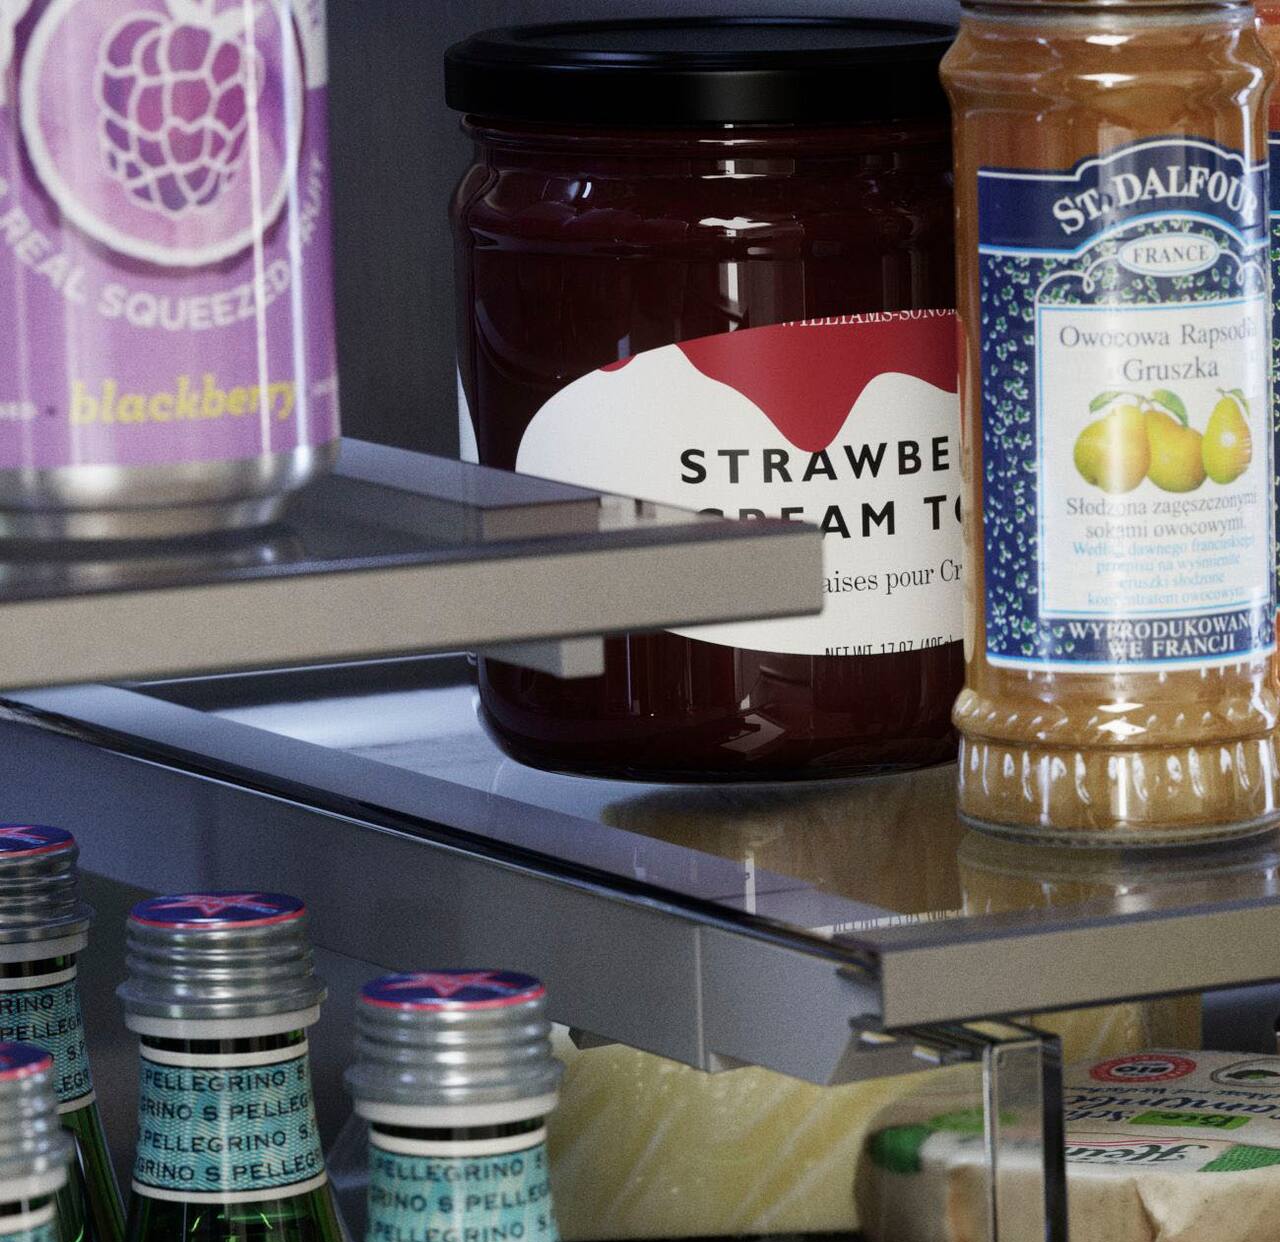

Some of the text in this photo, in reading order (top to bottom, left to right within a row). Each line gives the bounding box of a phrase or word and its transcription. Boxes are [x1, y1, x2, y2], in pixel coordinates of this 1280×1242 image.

[1052, 188, 1111, 236] ST.
[0, 205, 90, 303] REAL
[100, 257, 291, 331] SQUEEZED
[1132, 246, 1210, 265] FRANCE
[1058, 324, 1170, 348] Owocowa
[1122, 358, 1219, 382] Gruszka
[69, 370, 298, 426] blackberry
[679, 435, 964, 486] STRAWBE
[922, 495, 963, 532] T
[885, 567, 936, 596] pour
[1069, 613, 1256, 639] WYPRODUKOWAN
[1107, 634, 1236, 659] WE FRANCJI
[0, 1012, 82, 1041] PELLEG
[145, 1070, 286, 1093] PELLEGRINO
[144, 1129, 287, 1153] PELLEGRINO
